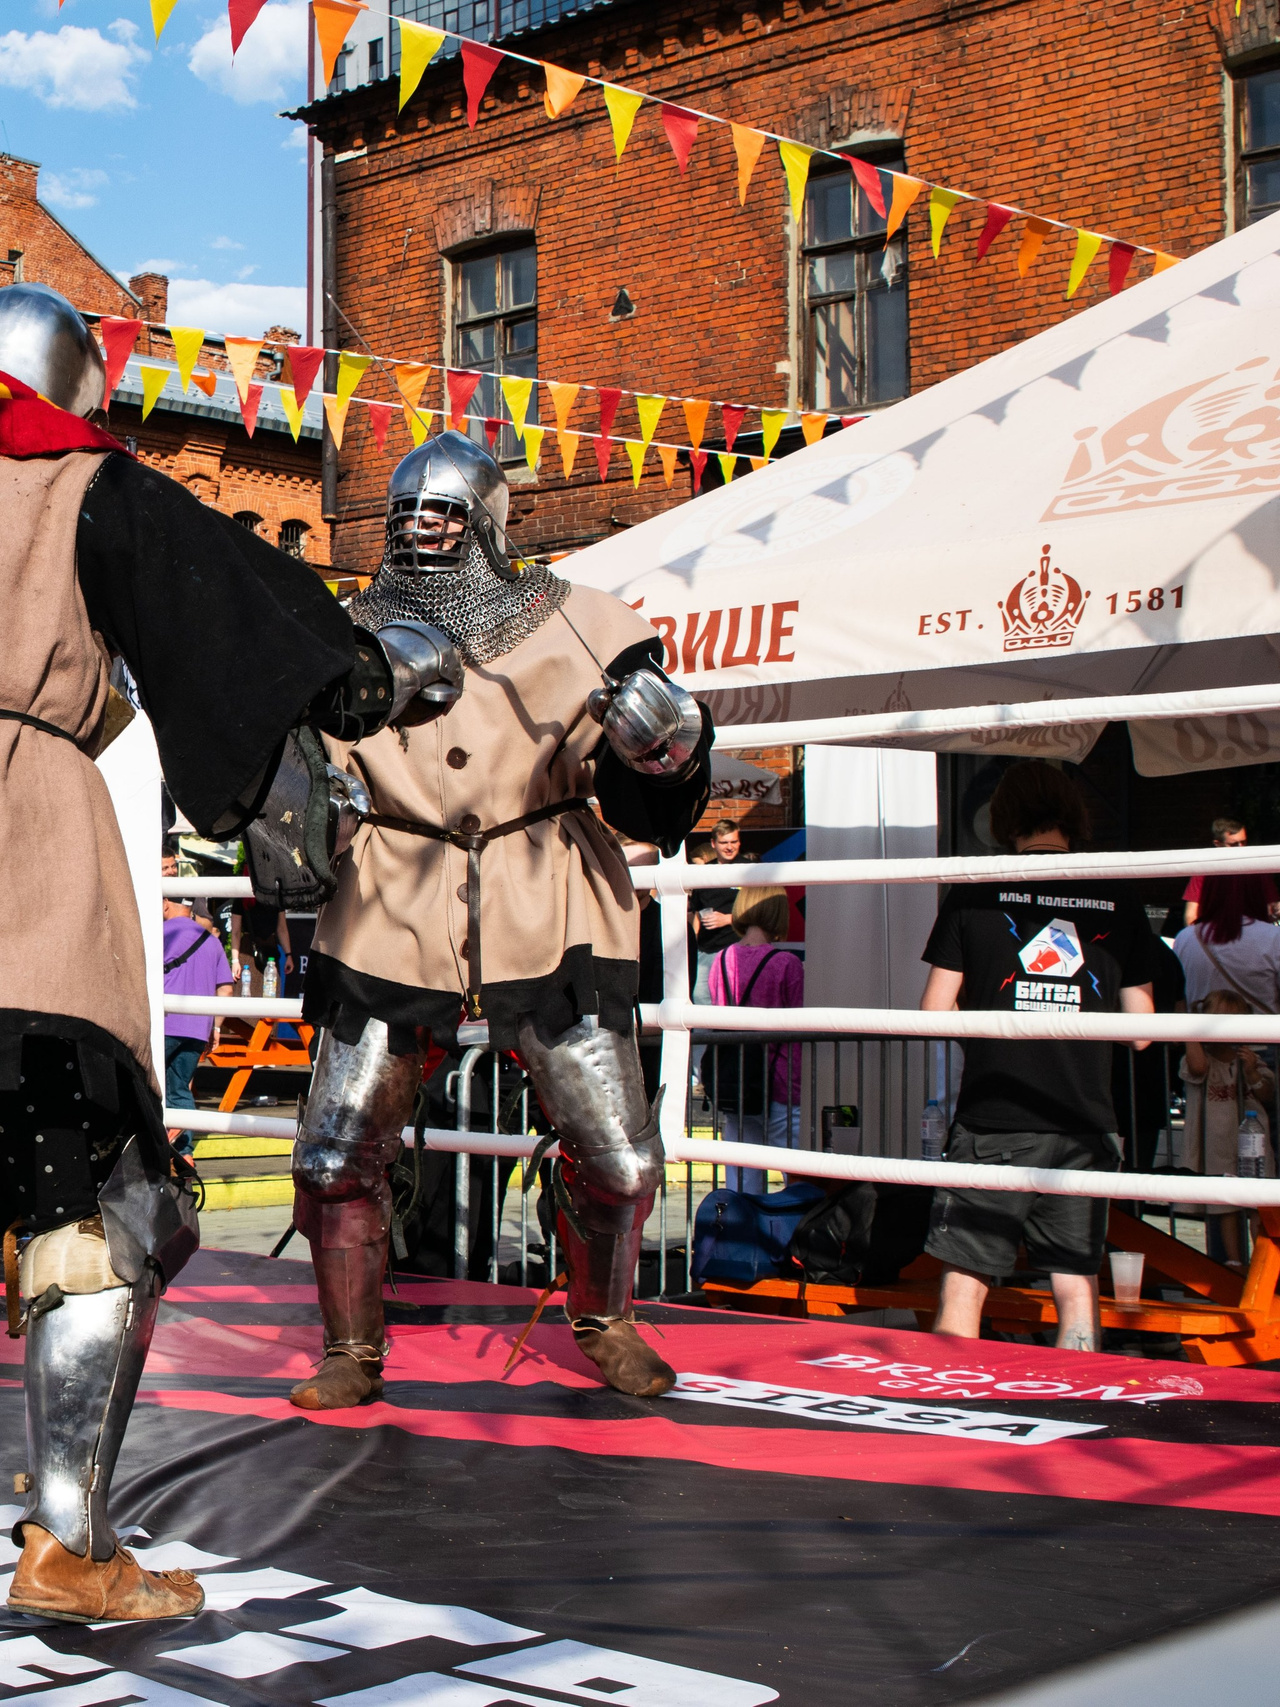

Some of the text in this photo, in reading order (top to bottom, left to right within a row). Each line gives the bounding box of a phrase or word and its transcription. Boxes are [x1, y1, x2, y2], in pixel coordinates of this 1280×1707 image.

[918, 585, 1184, 636] EST. 1581
[650, 600, 799, 676] ВИЦЕ
[999, 892, 1116, 912] ИЛЬЯ КОЛЕСНИКОВ
[1015, 981, 1081, 1003] БИТВА
[878, 1378, 993, 1400] GIN
